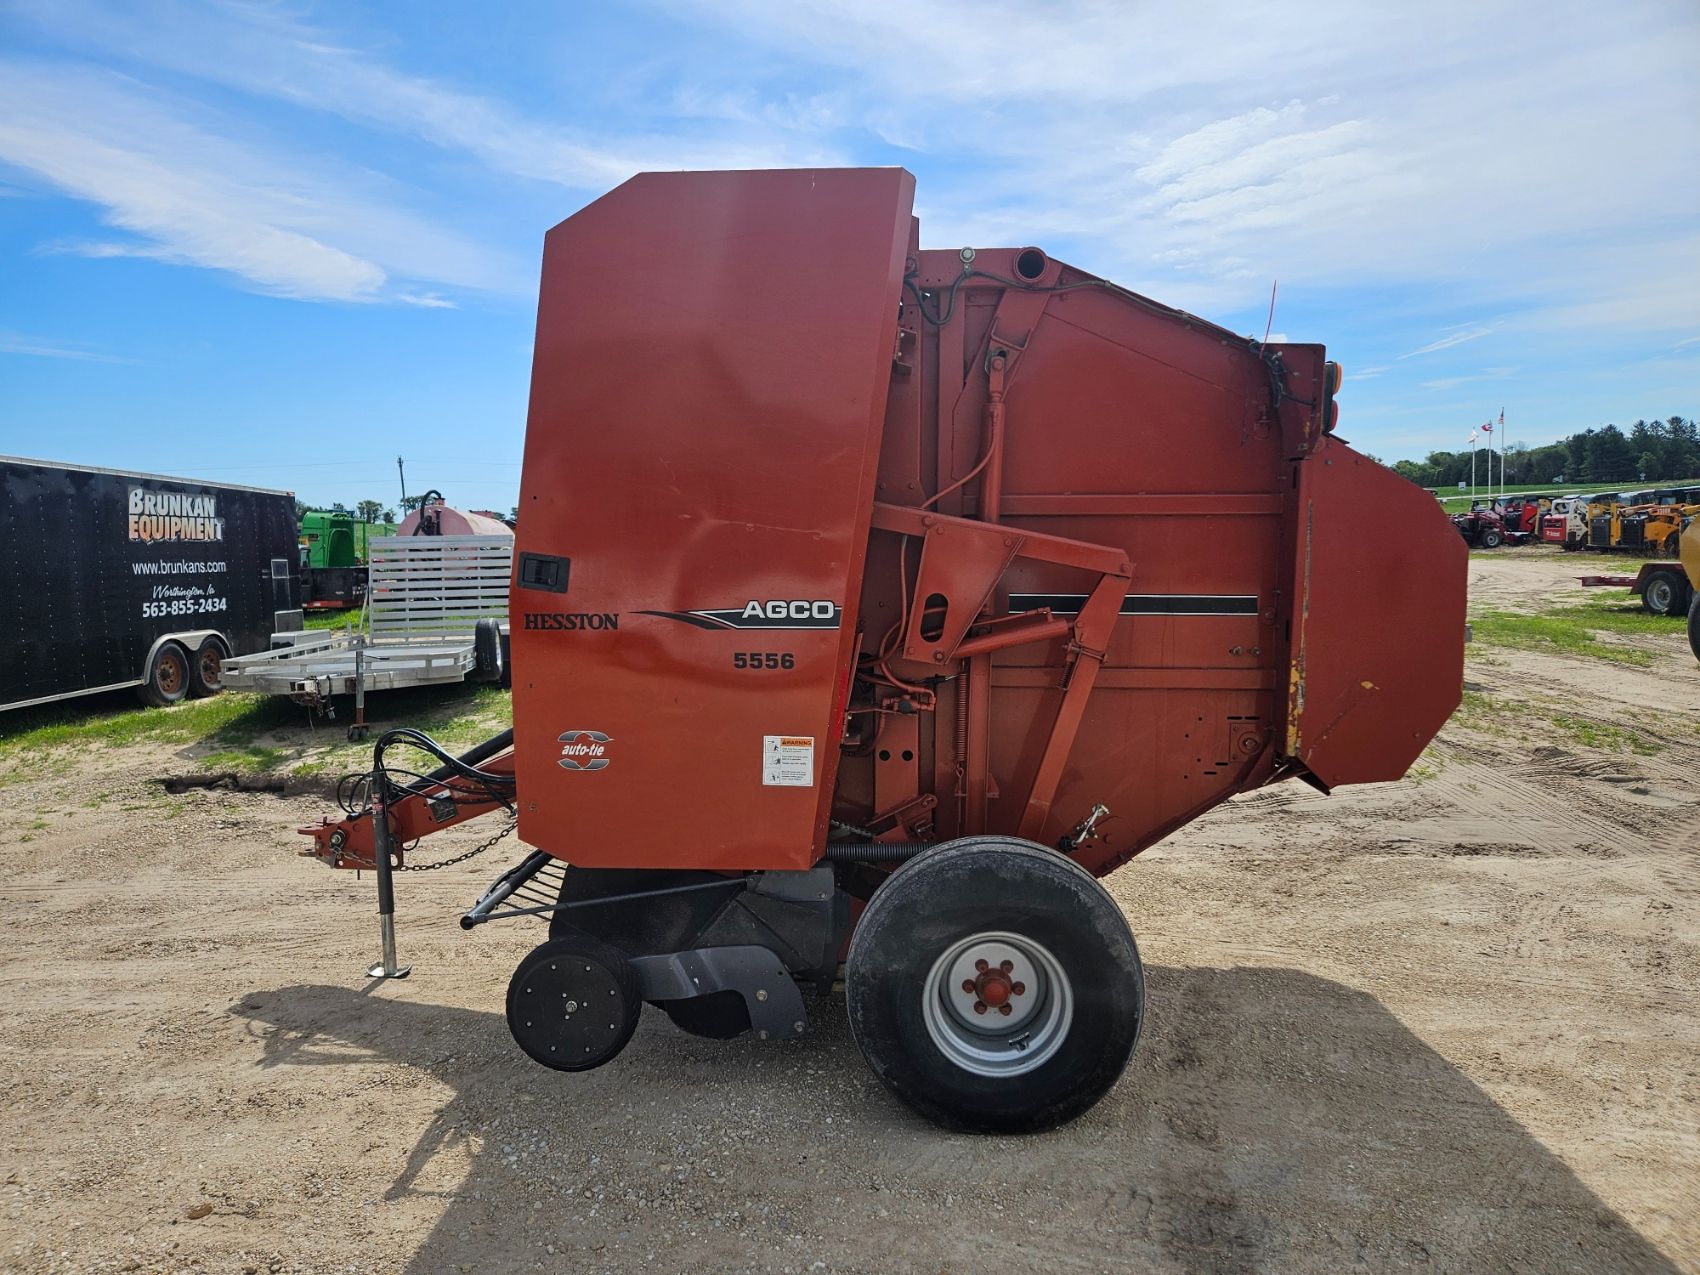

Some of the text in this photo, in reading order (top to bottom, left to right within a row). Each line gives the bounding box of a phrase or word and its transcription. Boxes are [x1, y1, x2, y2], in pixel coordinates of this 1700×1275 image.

[129, 489, 215, 517] BRUNKAN
[129, 516, 224, 543] EQUIPMENT
[132, 559, 227, 575] www.brunkans.com
[142, 598, 227, 618] 563-855-2434
[742, 600, 834, 619] AGCO
[524, 613, 619, 630] HESSTON
[734, 653, 794, 669] 5556
[561, 743, 605, 756] auto-tie
